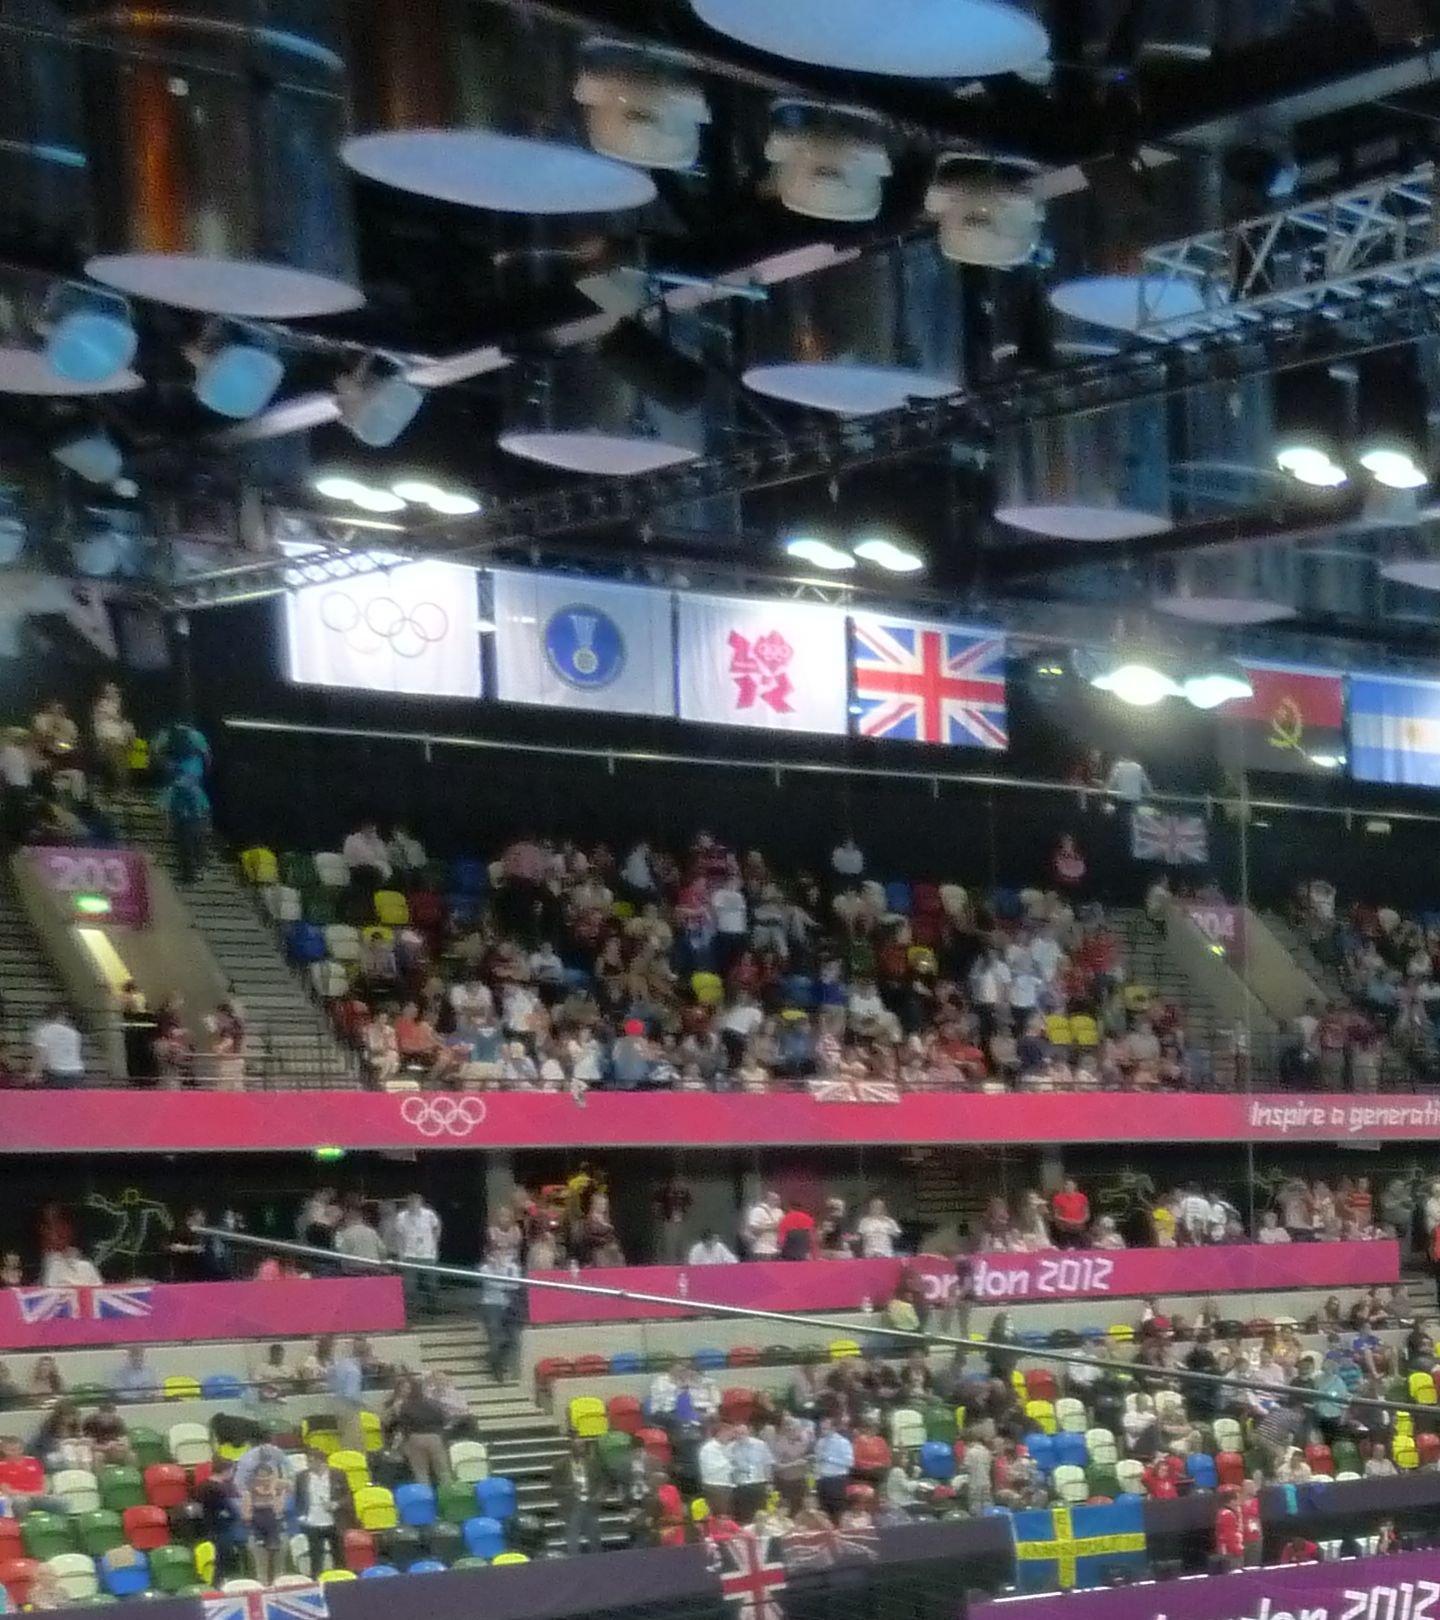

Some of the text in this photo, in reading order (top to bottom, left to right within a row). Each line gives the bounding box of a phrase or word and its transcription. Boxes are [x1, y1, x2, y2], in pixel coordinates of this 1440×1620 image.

[49, 855, 130, 894] 203
[1251, 1099, 1325, 1133] Inspire
[1330, 1107, 1346, 1126] a
[1037, 1257, 1114, 1293] 2012
